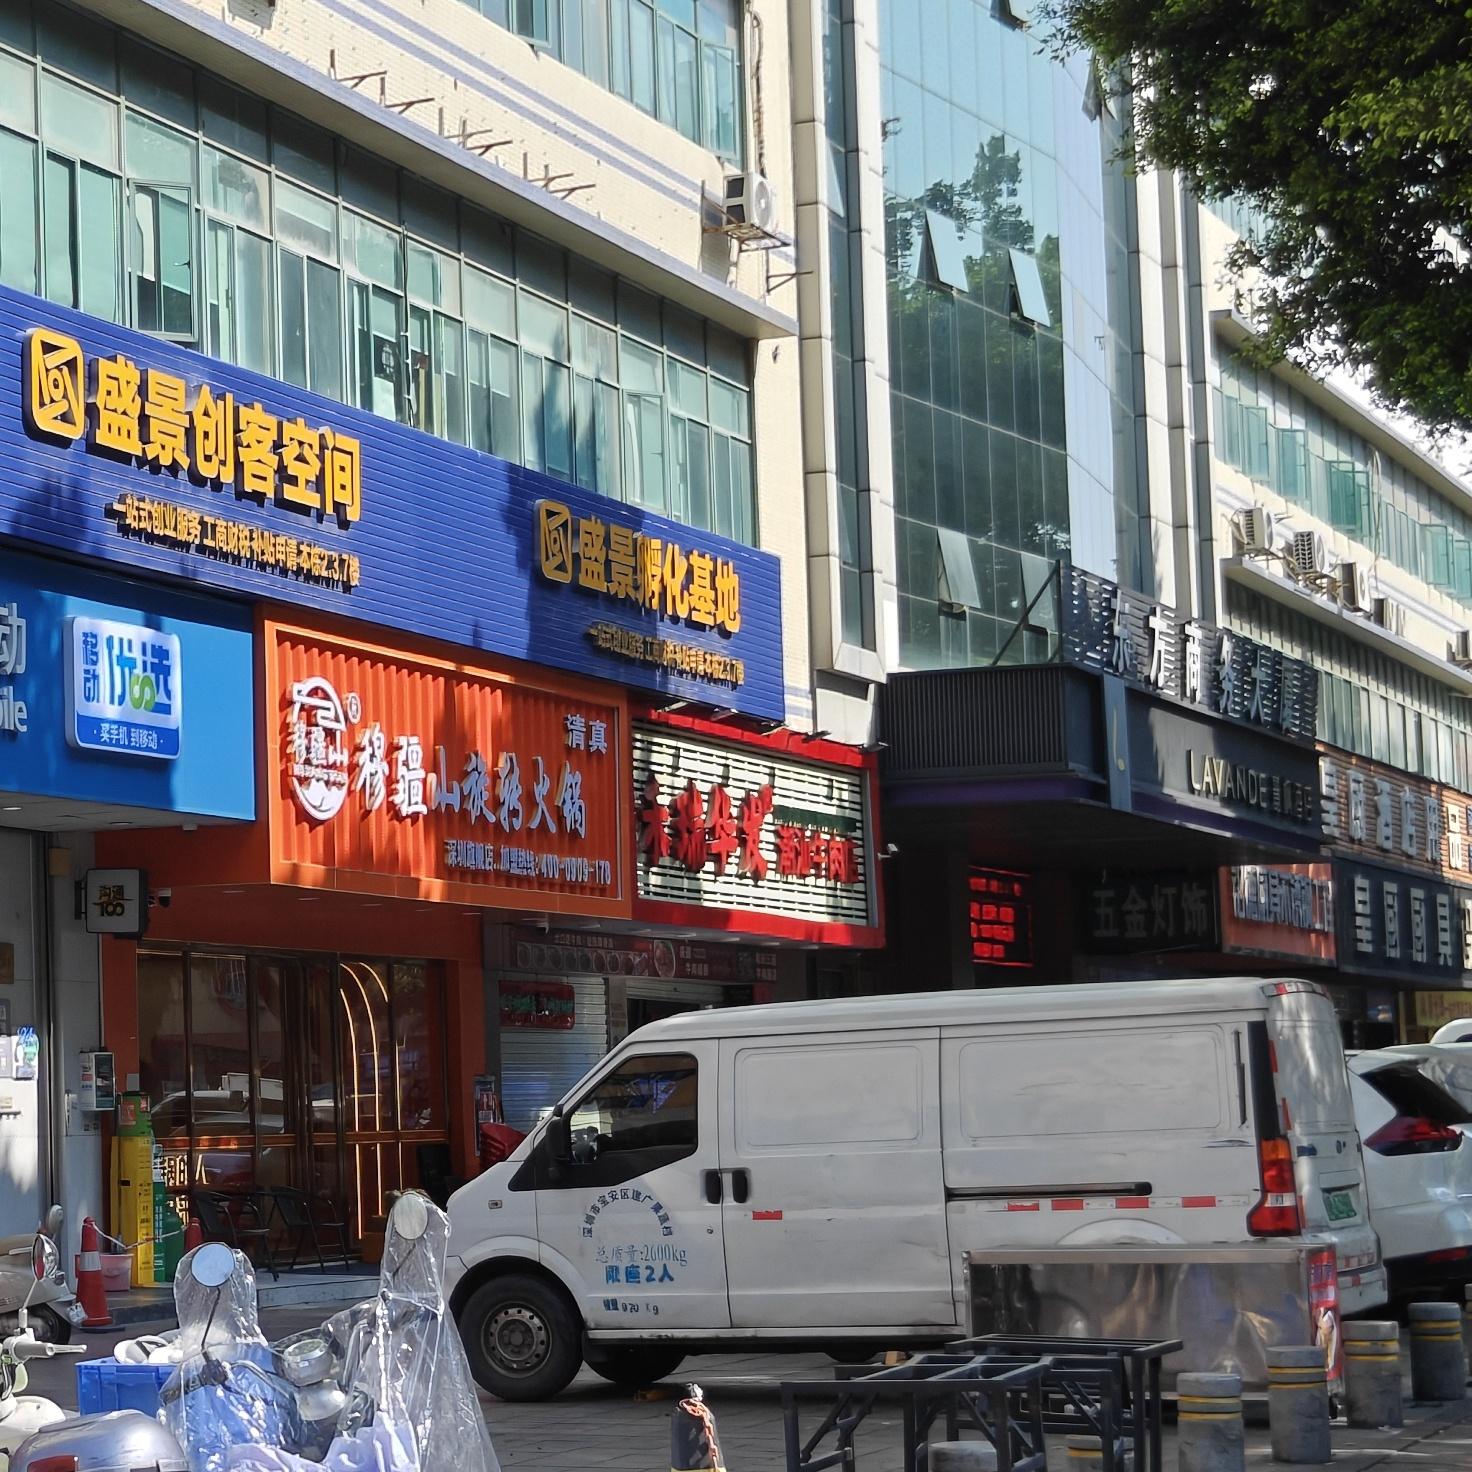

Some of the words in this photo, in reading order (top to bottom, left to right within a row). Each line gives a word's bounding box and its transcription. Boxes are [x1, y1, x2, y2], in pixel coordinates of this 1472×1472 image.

[92, 355, 362, 522] 盛景创客空间
[577, 516, 742, 634] 盛景孵化基地
[81, 630, 101, 705] 移动
[103, 633, 173, 716] 优选
[99, 725, 129, 747] 买手机
[130, 728, 159, 751] 到移动
[567, 713, 608, 755] 清真
[1186, 749, 1268, 808] LAVANDE
[98, 902, 125, 917] 100
[1093, 881, 1210, 940] 五金灯饰
